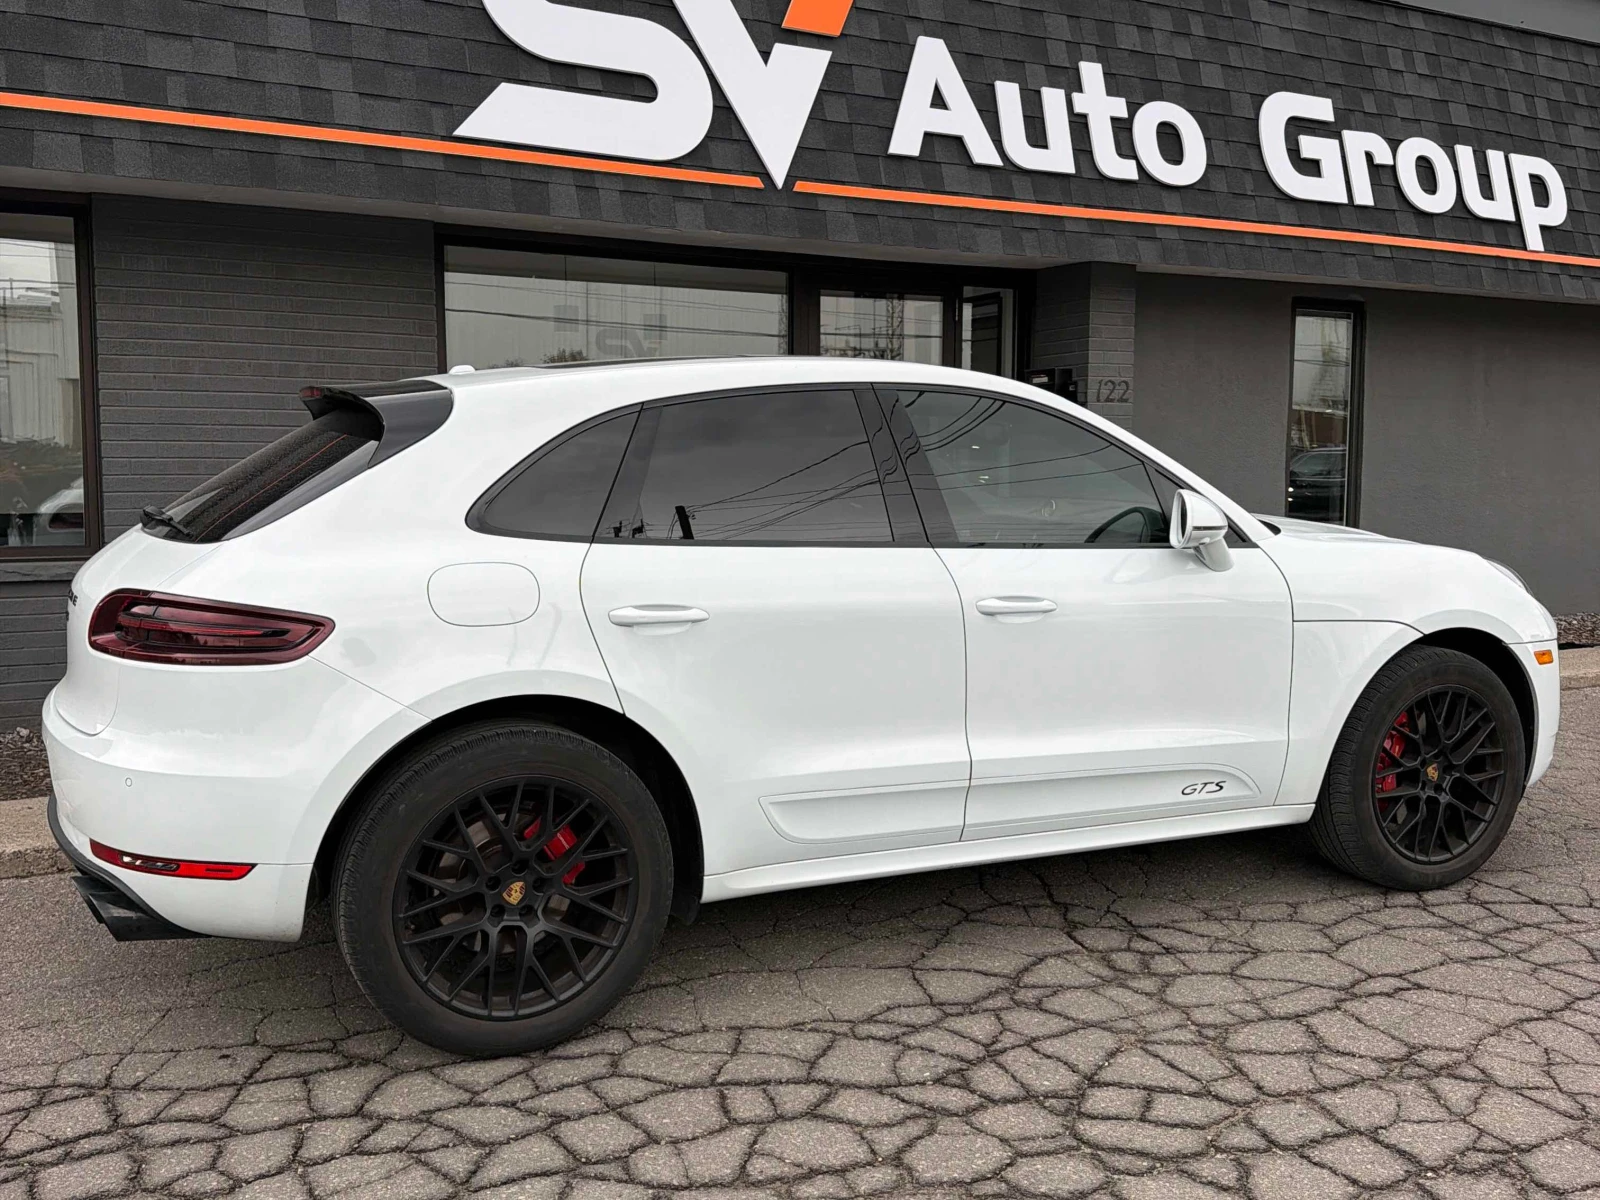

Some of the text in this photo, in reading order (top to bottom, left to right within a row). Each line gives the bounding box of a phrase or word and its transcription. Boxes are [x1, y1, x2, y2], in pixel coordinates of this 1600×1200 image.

[453, 0, 1568, 252] SV Auto Group
[1095, 379, 1130, 403] 122
[1181, 780, 1227, 796] GTS
